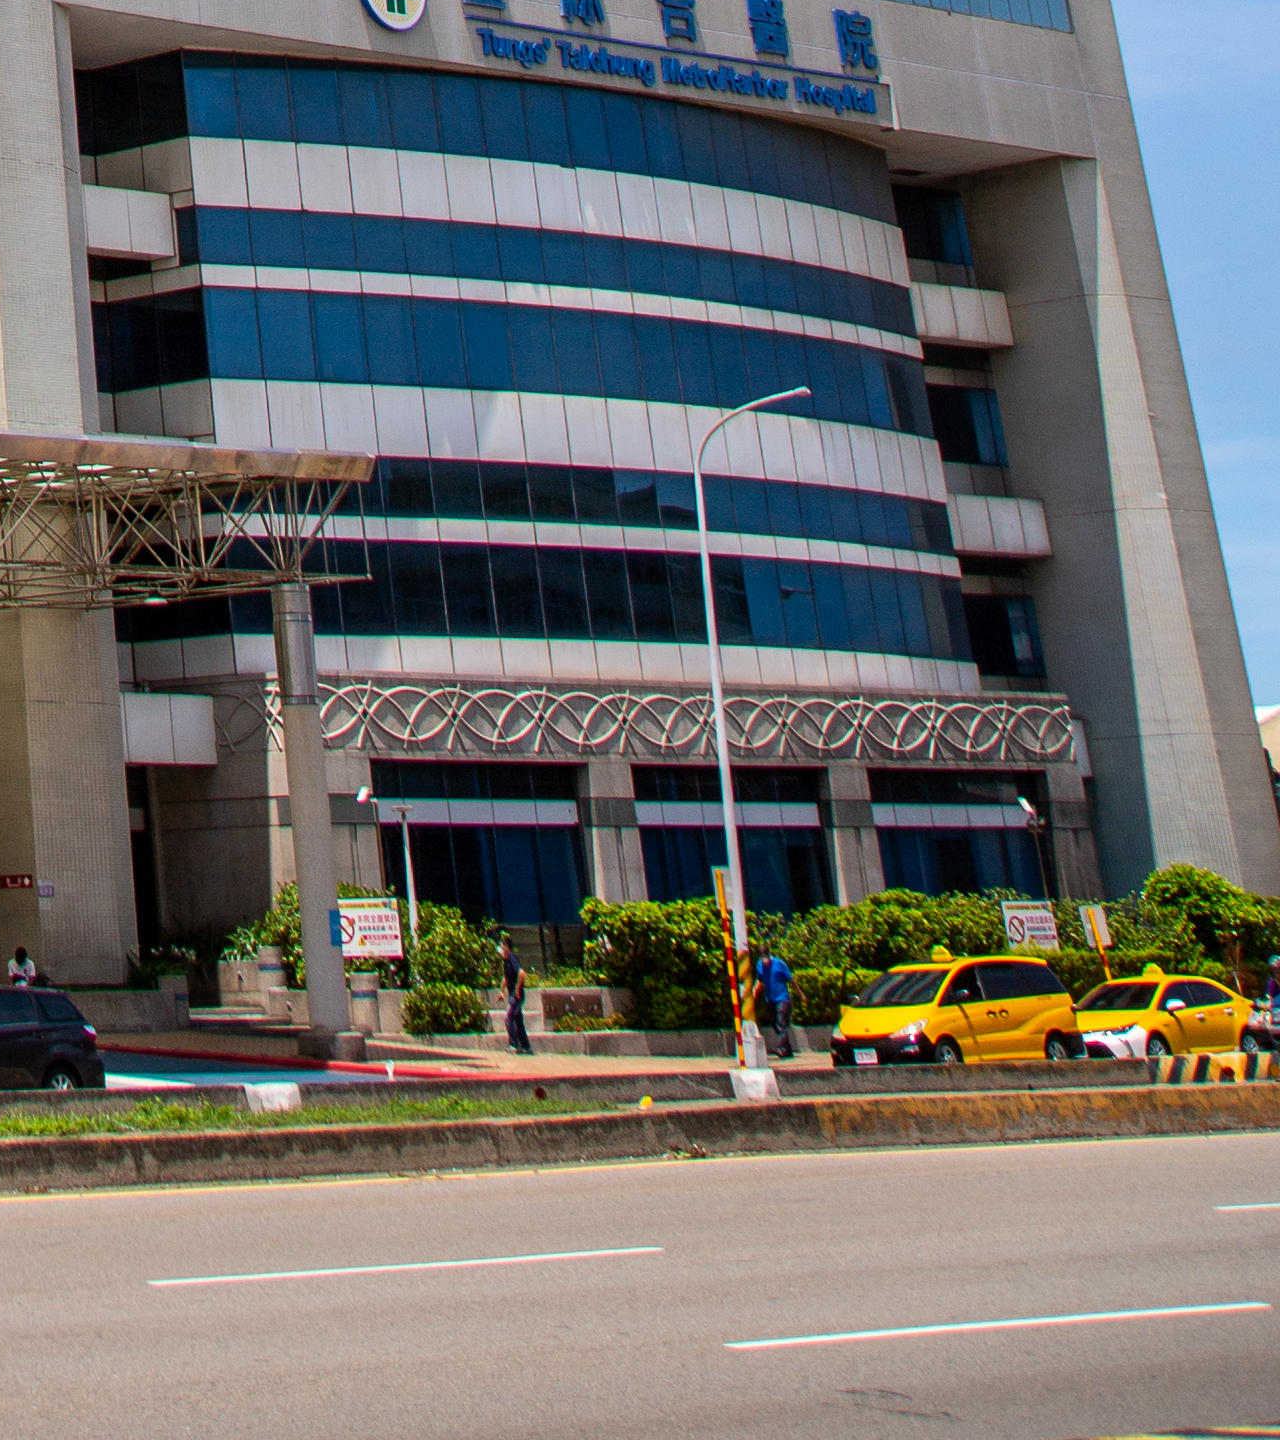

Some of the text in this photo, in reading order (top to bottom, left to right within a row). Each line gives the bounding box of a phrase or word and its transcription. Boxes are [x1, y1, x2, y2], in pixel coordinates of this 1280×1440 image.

[477, 27, 878, 115] Tungs' Taichung MetroHarbor Hospital
